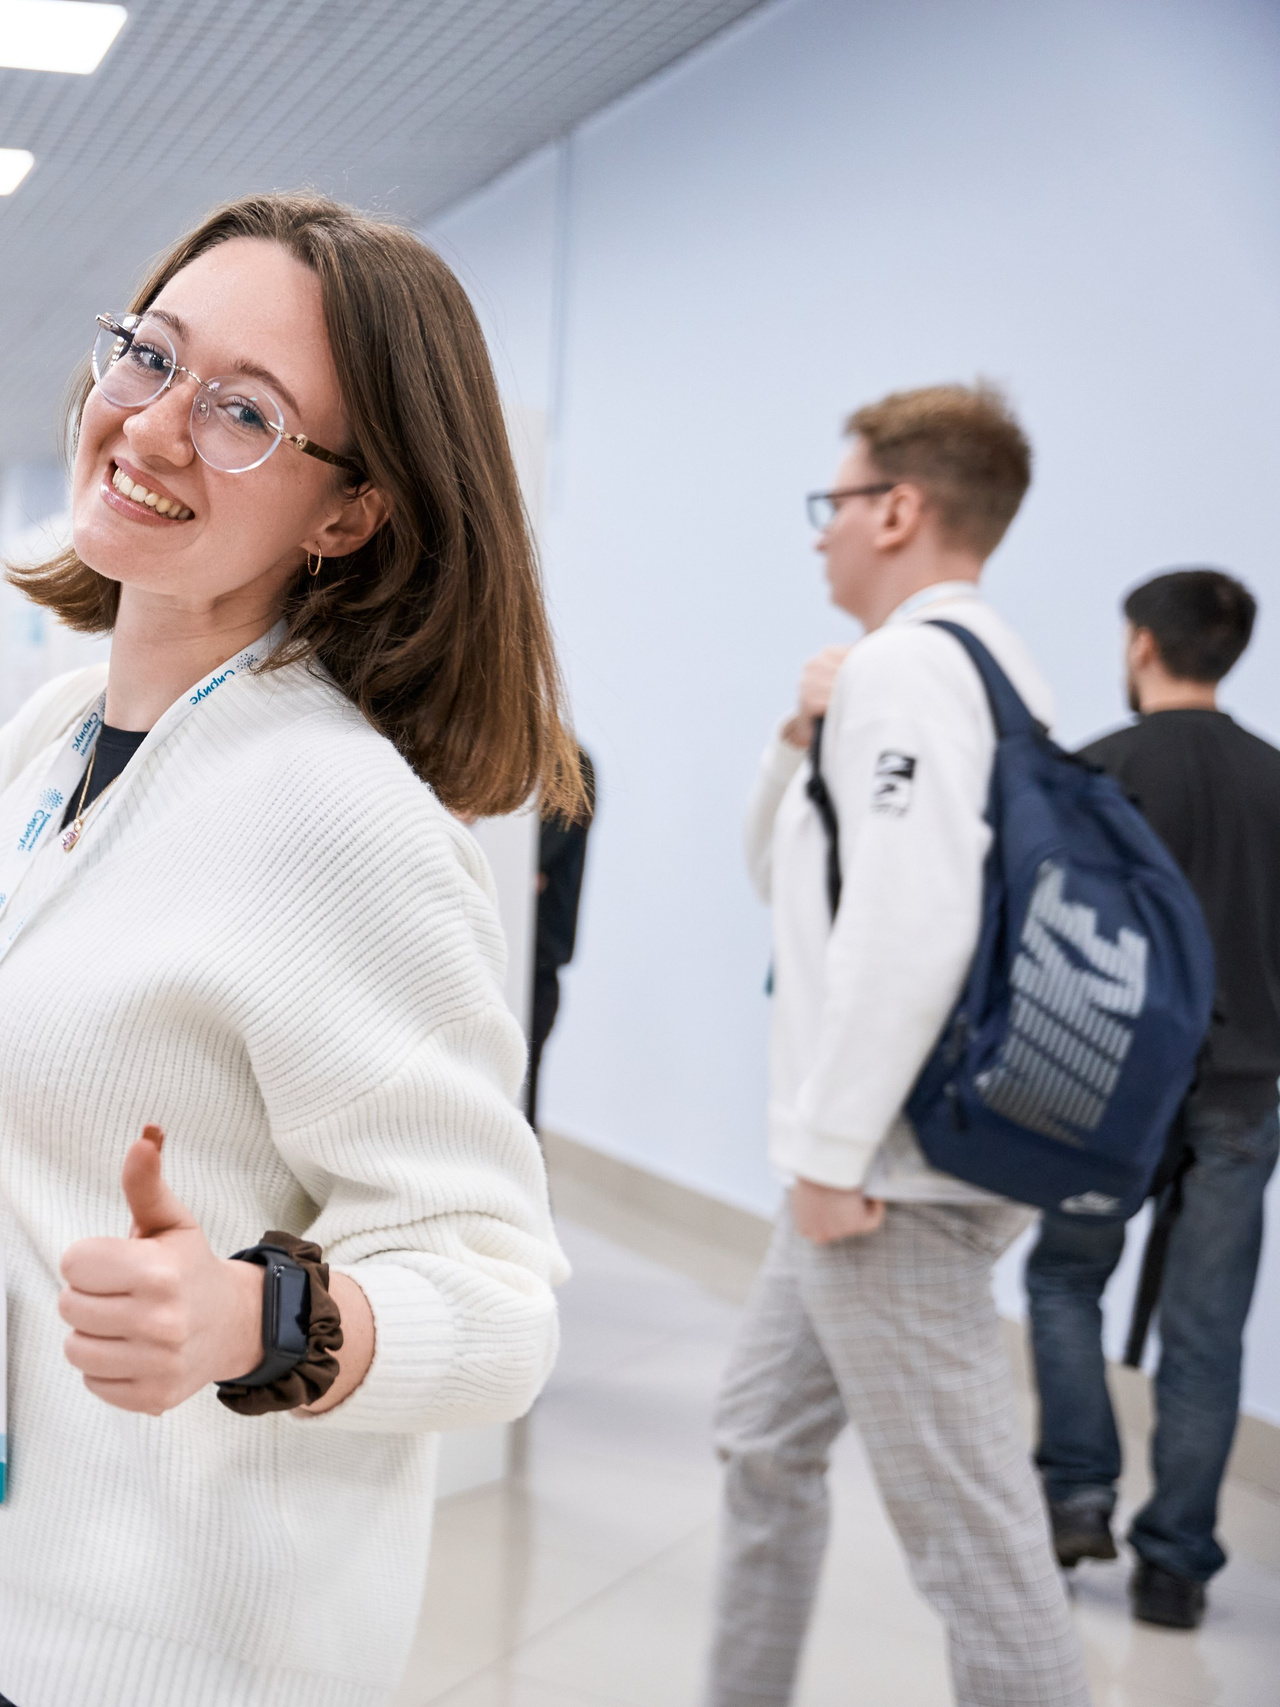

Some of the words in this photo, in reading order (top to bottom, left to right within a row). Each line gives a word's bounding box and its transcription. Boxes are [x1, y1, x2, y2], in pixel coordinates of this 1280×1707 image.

[71, 711, 99, 752] Сириус
[17, 809, 45, 851] Сириус
[976, 857, 1148, 1148] NIKE
